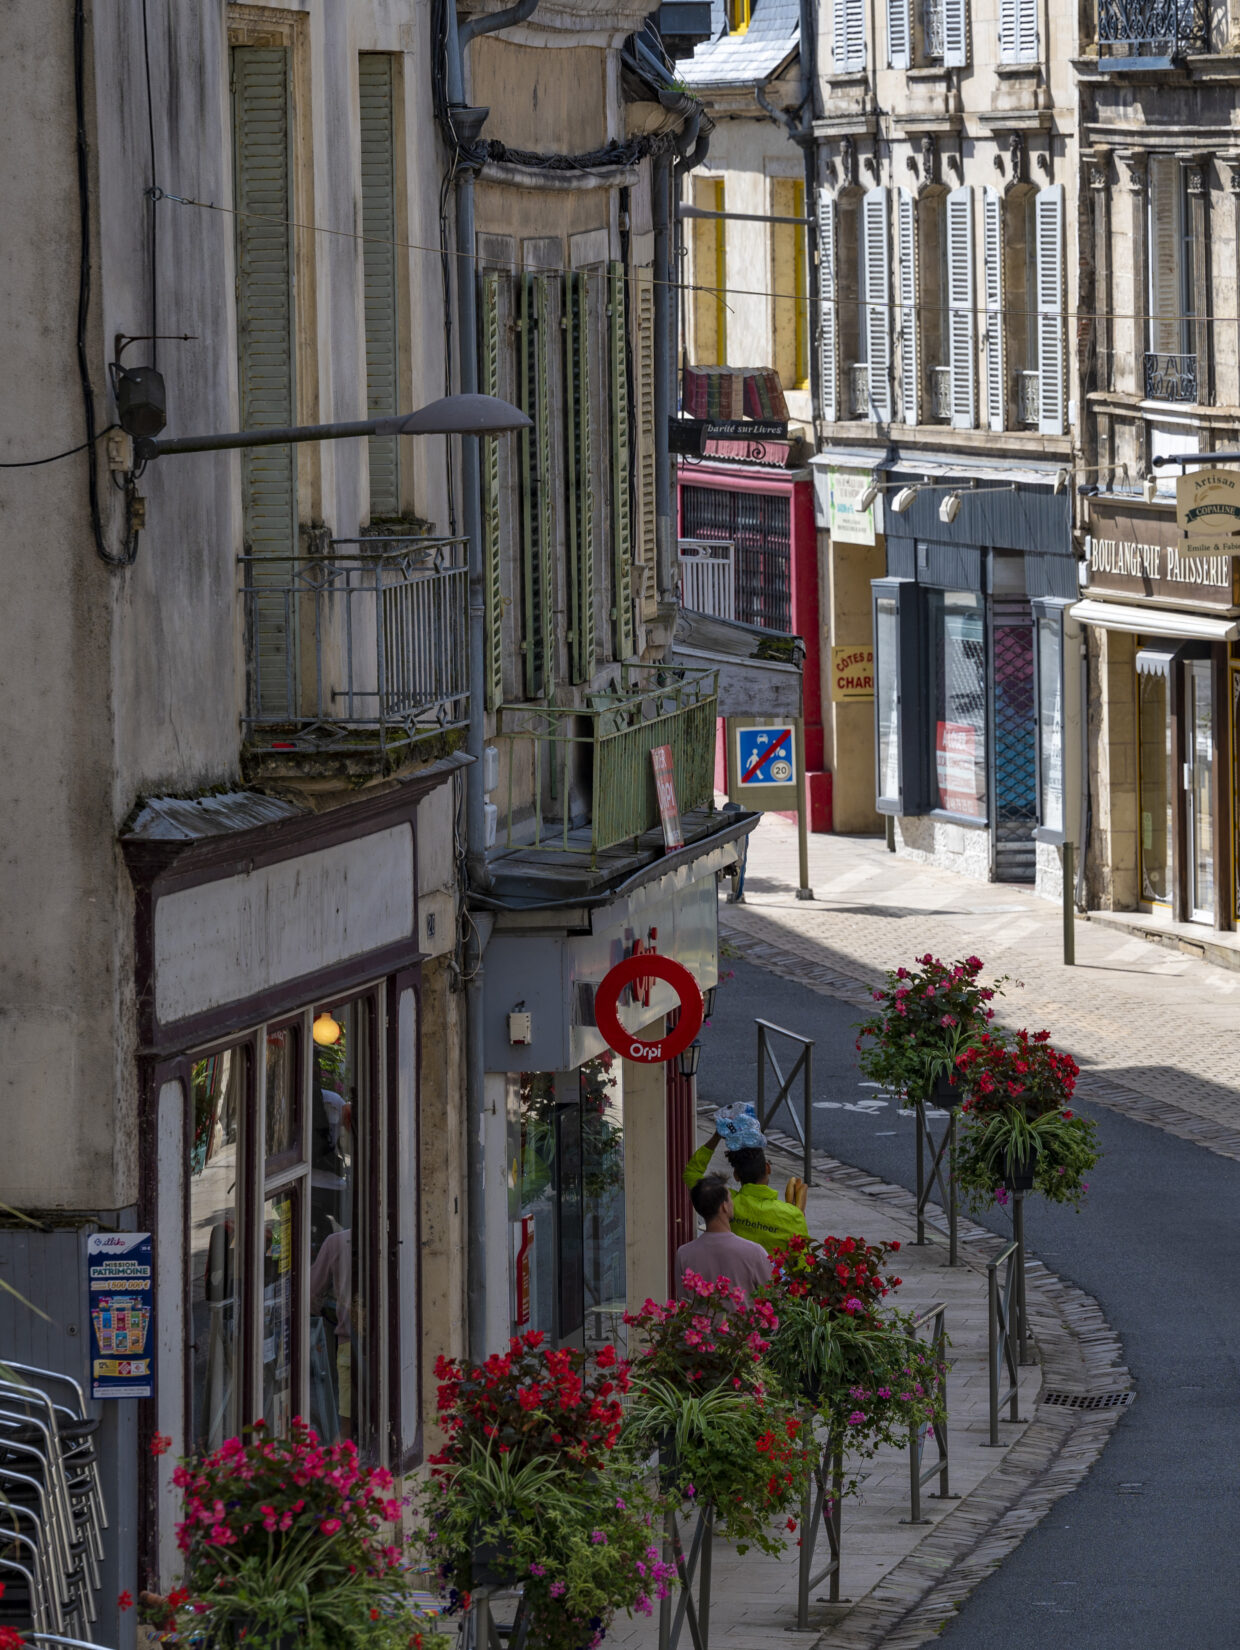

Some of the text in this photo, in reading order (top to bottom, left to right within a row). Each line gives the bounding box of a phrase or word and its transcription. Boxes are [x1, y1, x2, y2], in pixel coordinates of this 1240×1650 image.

[753, 426, 783, 434] Livres
[1194, 475, 1236, 490] Artisan
[1196, 505, 1236, 516] COPALINE
[1187, 544, 1211, 552] Emilie
[1091, 538, 1161, 580] BOULANGERIE
[775, 766, 787, 775] 20
[630, 1043, 662, 1061] Orpi
[92, 1267, 149, 1276] PATRIMOINE
